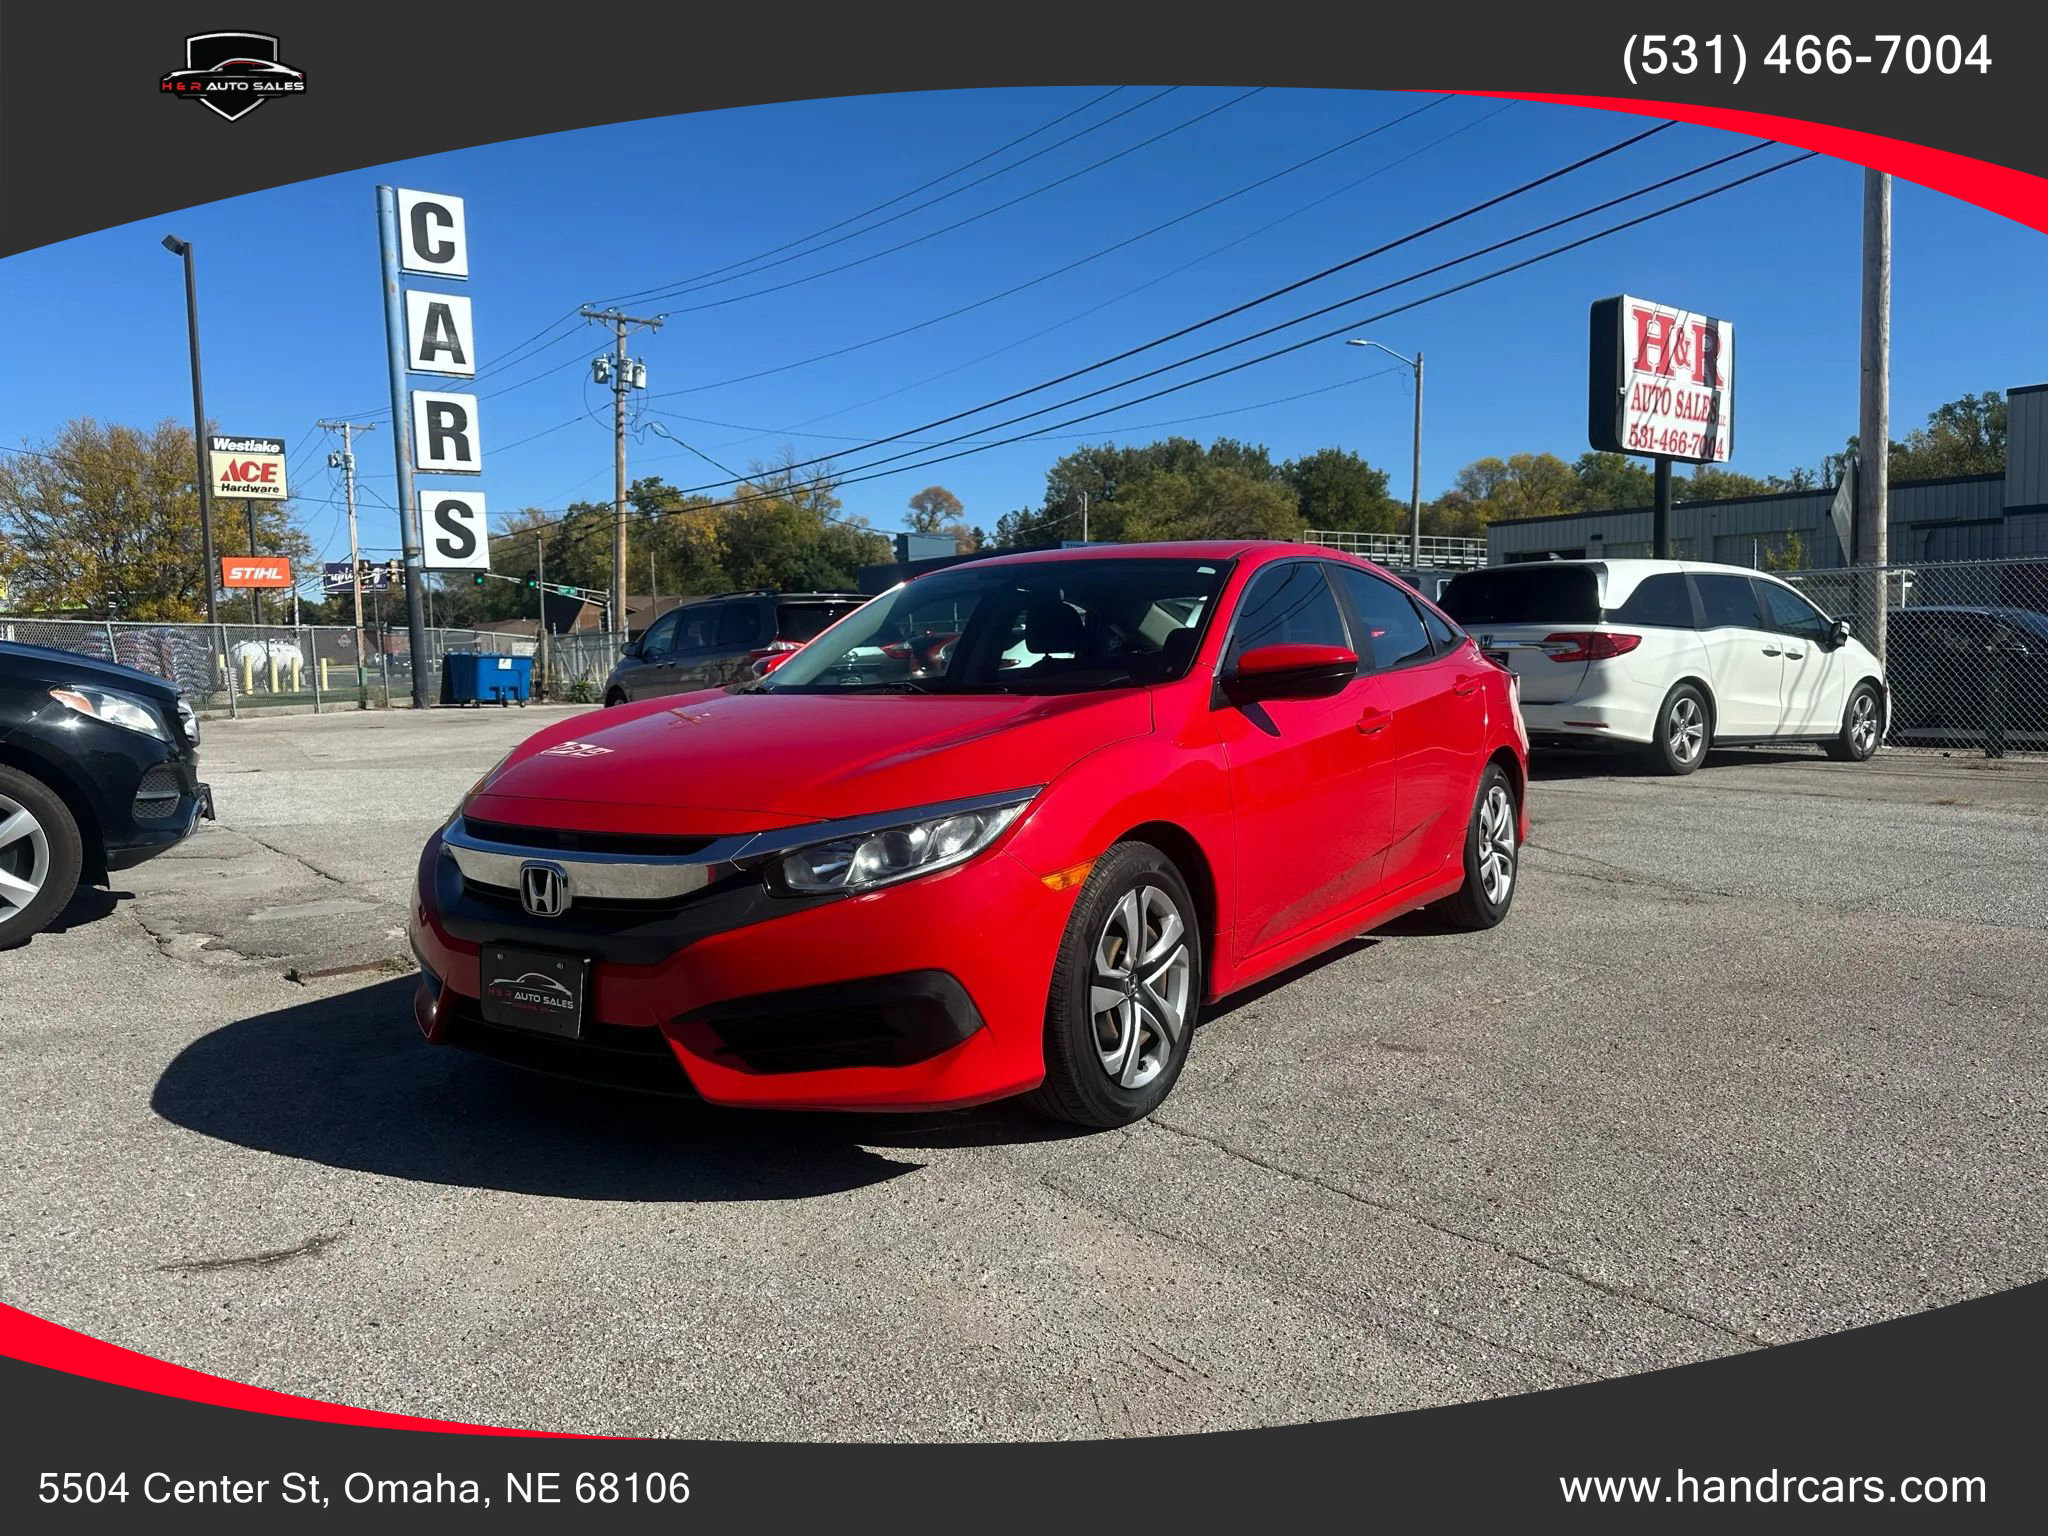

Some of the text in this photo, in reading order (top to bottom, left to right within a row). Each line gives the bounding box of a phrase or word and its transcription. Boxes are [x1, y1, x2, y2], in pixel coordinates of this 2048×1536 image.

[1631, 383, 1672, 416] AUTO
[1675, 389, 1718, 425] SALES
[213, 437, 281, 453] Westlake
[1629, 423, 1725, 460] 531-466-7004
[220, 458, 279, 483] ACE
[221, 483, 280, 493] Hardware
[229, 567, 284, 580] STIHL
[514, 991, 541, 1003] AUTO
[543, 996, 574, 1009] SALES
